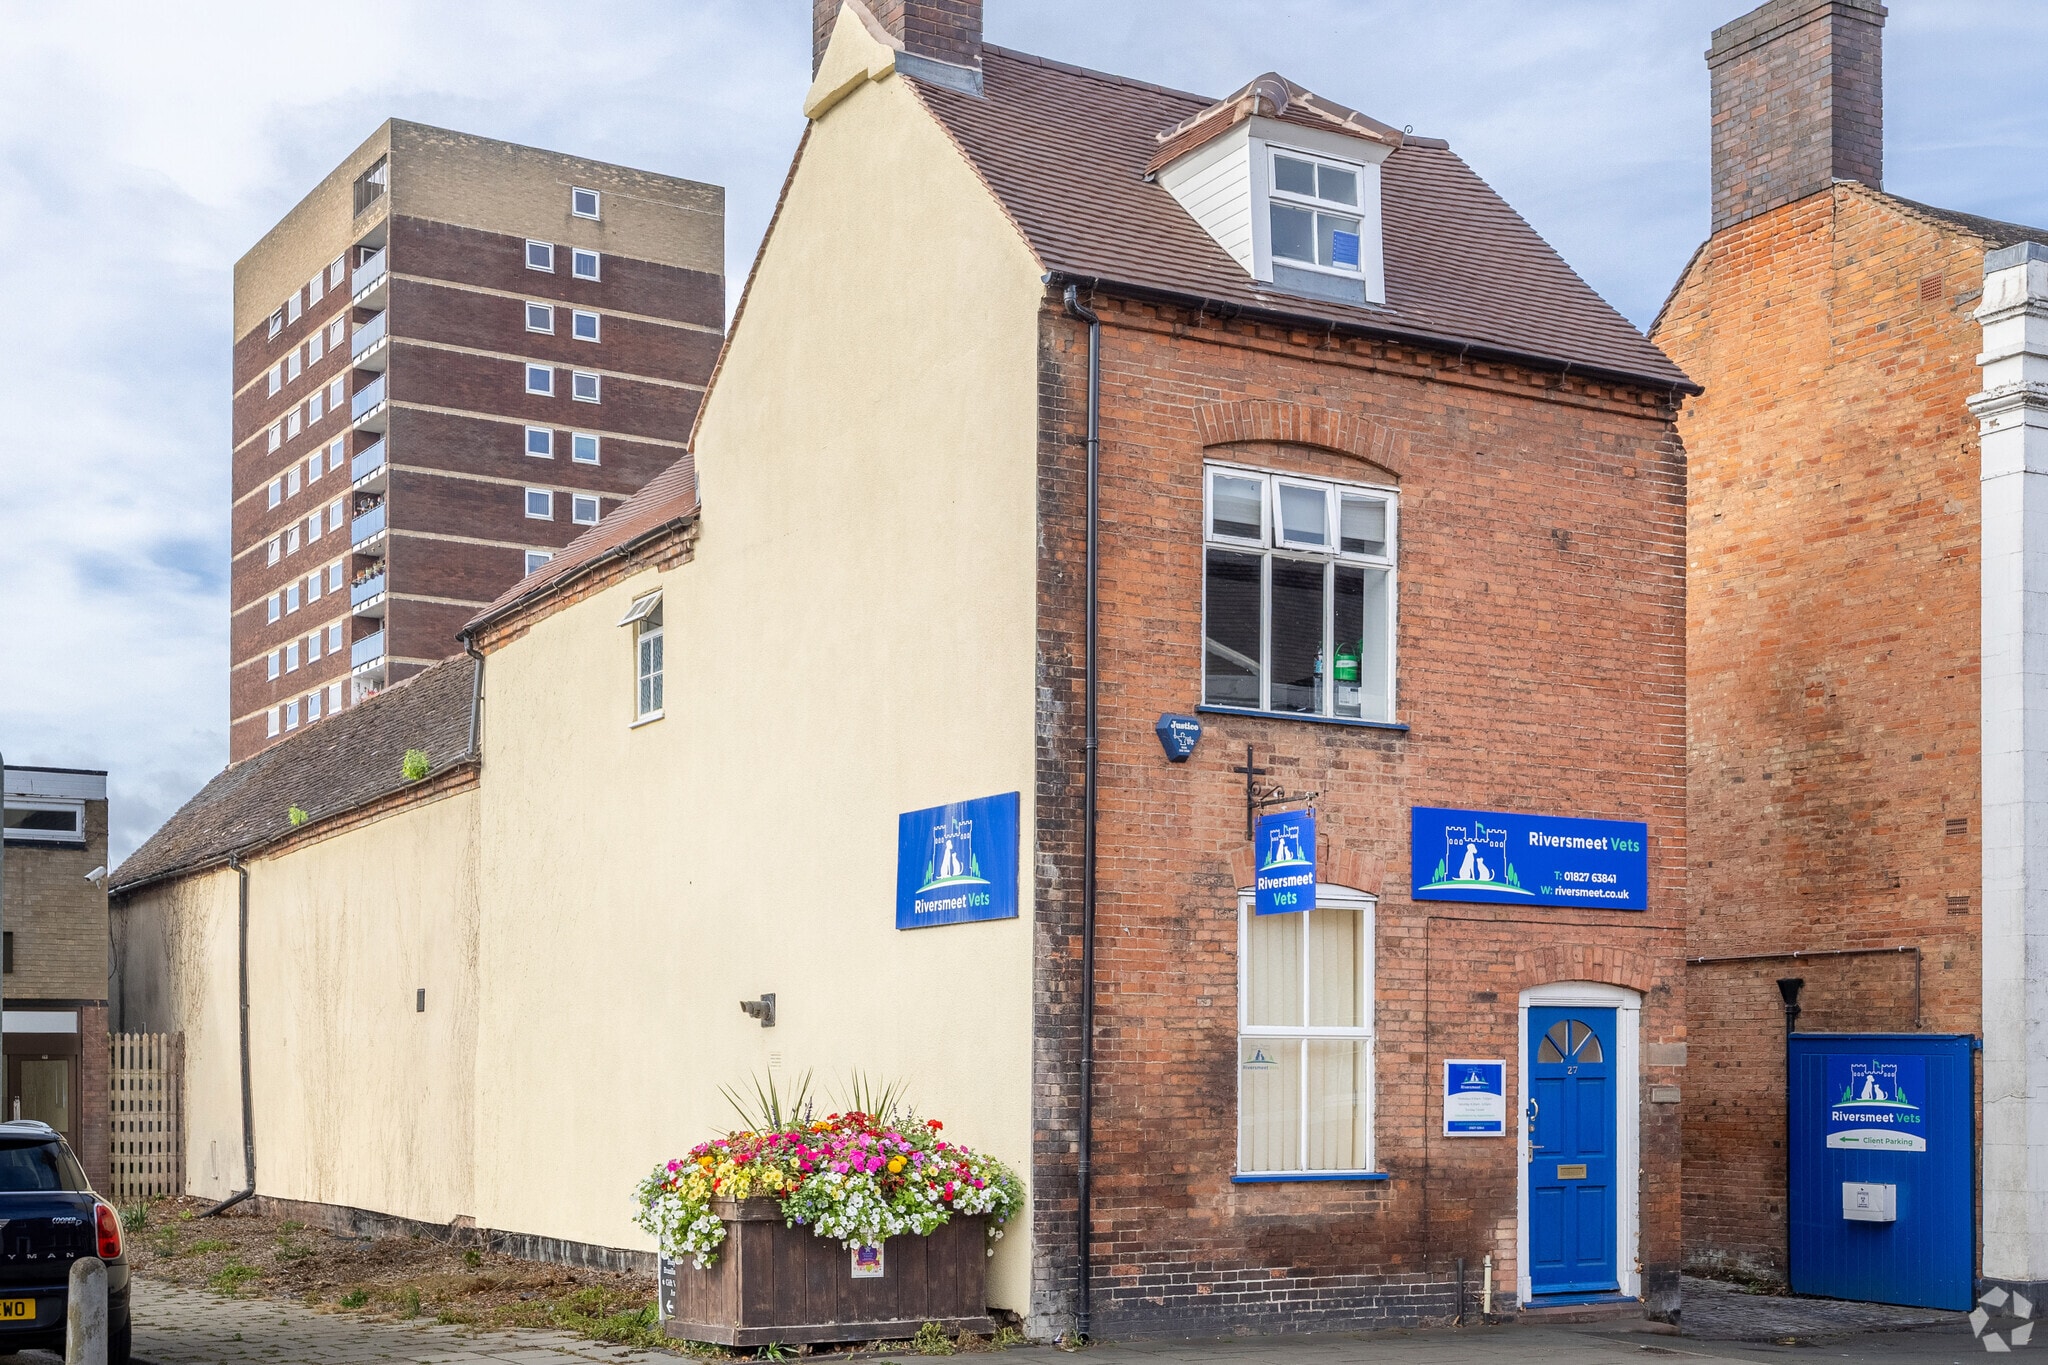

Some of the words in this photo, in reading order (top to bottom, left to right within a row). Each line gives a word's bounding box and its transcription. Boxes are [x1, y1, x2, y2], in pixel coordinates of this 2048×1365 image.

[1170, 720, 1199, 731] Justice
[1529, 831, 1608, 850] Riversmeet
[1610, 837, 1640, 852] Vets
[1258, 871, 1314, 890] Riversmeet
[1554, 870, 1562, 880] T:
[1564, 871, 1590, 882] 01827
[1591, 873, 1617, 884] 63841
[1273, 891, 1298, 906] Vets
[1540, 885, 1553, 895] W:
[1554, 885, 1630, 899] riversmeet.co.uk
[914, 894, 967, 914] Riversmeet
[968, 893, 990, 907] Vets
[1567, 1065, 1578, 1075] 27
[1831, 1111, 1894, 1123] Riversmeet
[1896, 1113, 1921, 1123] Vets
[1885, 1138, 1913, 1147] Parking
[52, 1216, 77, 1225] COOPER
[0, 1302, 25, 1316] WO
